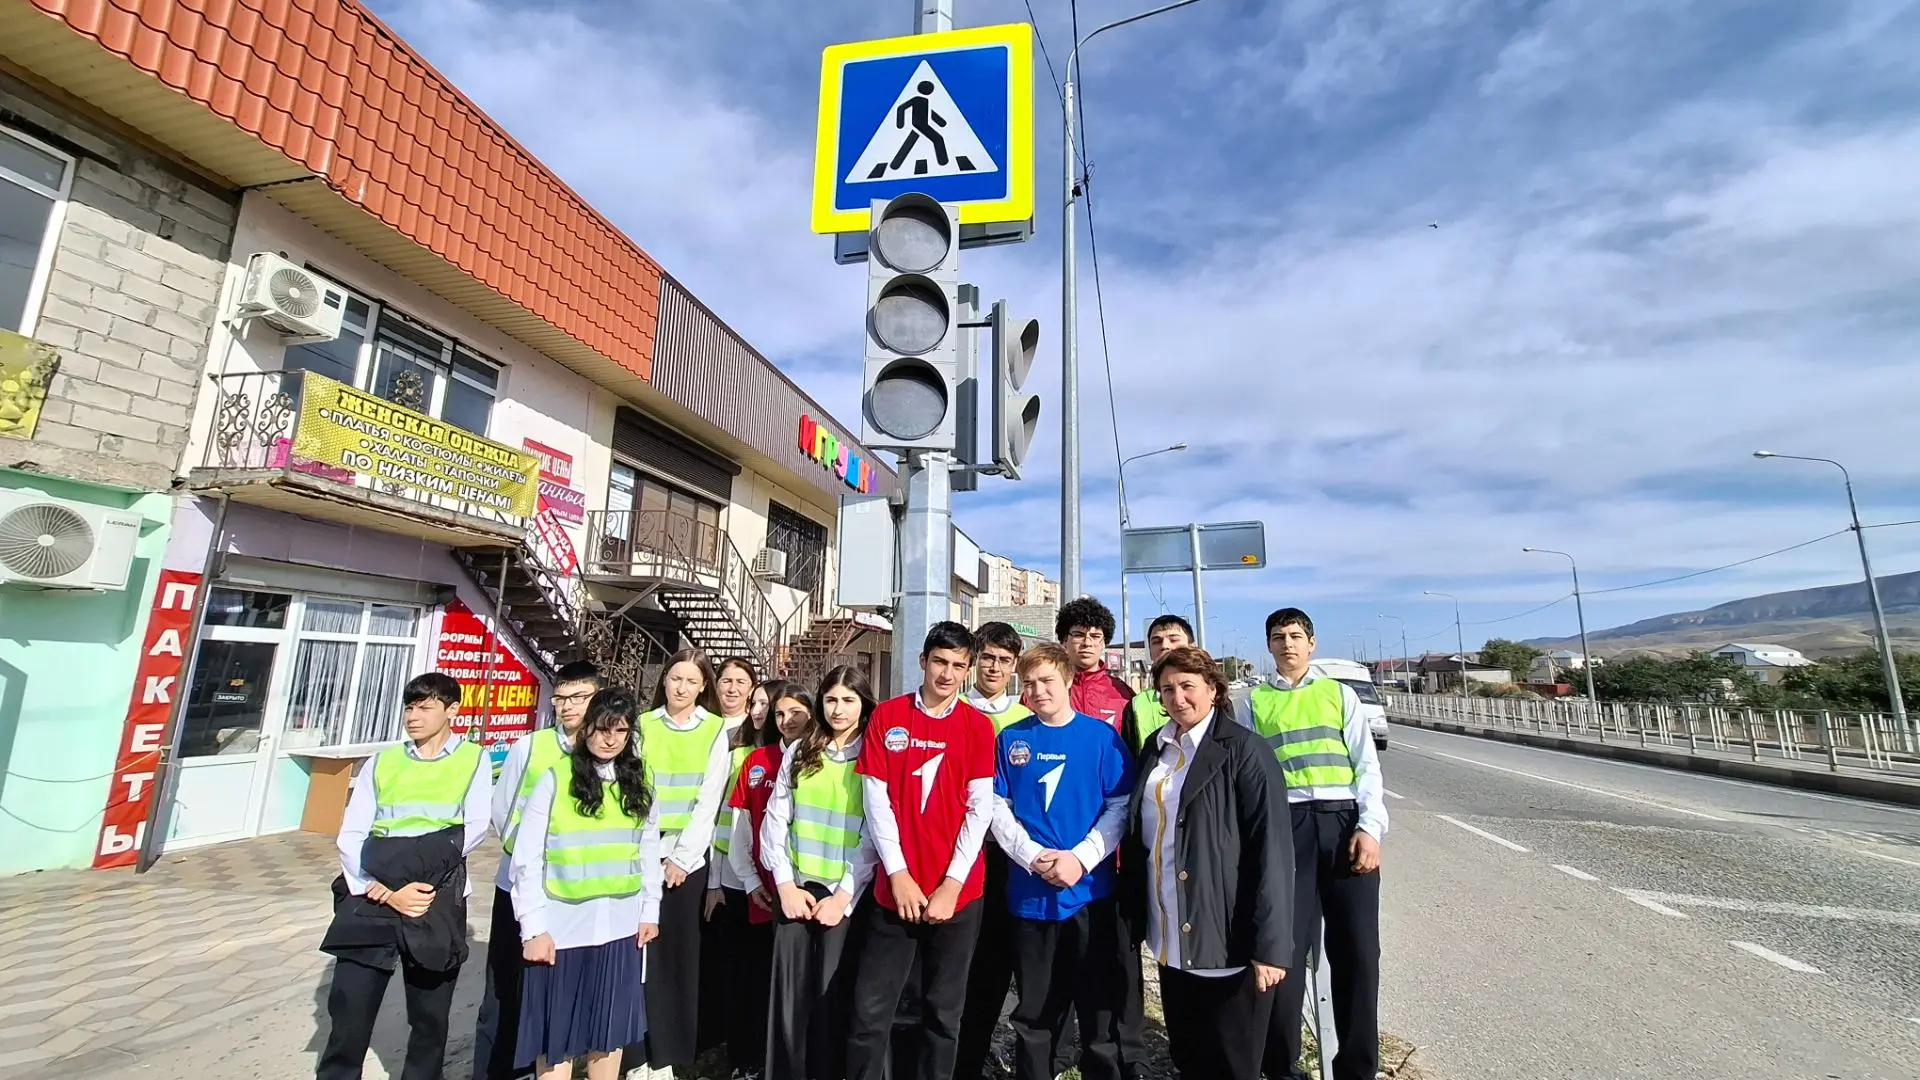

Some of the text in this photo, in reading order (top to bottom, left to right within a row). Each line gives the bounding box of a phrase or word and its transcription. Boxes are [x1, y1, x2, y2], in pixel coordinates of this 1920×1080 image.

[332, 410, 527, 485] ПЛАТЬЯ КОСТЮМЫ ЖИЛЕТЫ
[338, 389, 520, 469] ЖЕНСКАЯ ОДЕЖДА
[370, 441, 500, 490] ХАЛАТЫ ТАПОЧКИ
[799, 414, 877, 495] ИГРУШКИ
[342, 449, 513, 510] ПО НИЗКИМ ЦЕНАМ!
[440, 632, 484, 645] ФОРМЫ
[217, 694, 245, 702] ЗАКРЫТО
[497, 684, 539, 712] ЦЕНЫ
[100, 582, 198, 856] ПАКЕТЫ
[489, 713, 528, 726] ХИМИЯ
[911, 738, 947, 751] Первые
[1036, 752, 1067, 762] Первые
